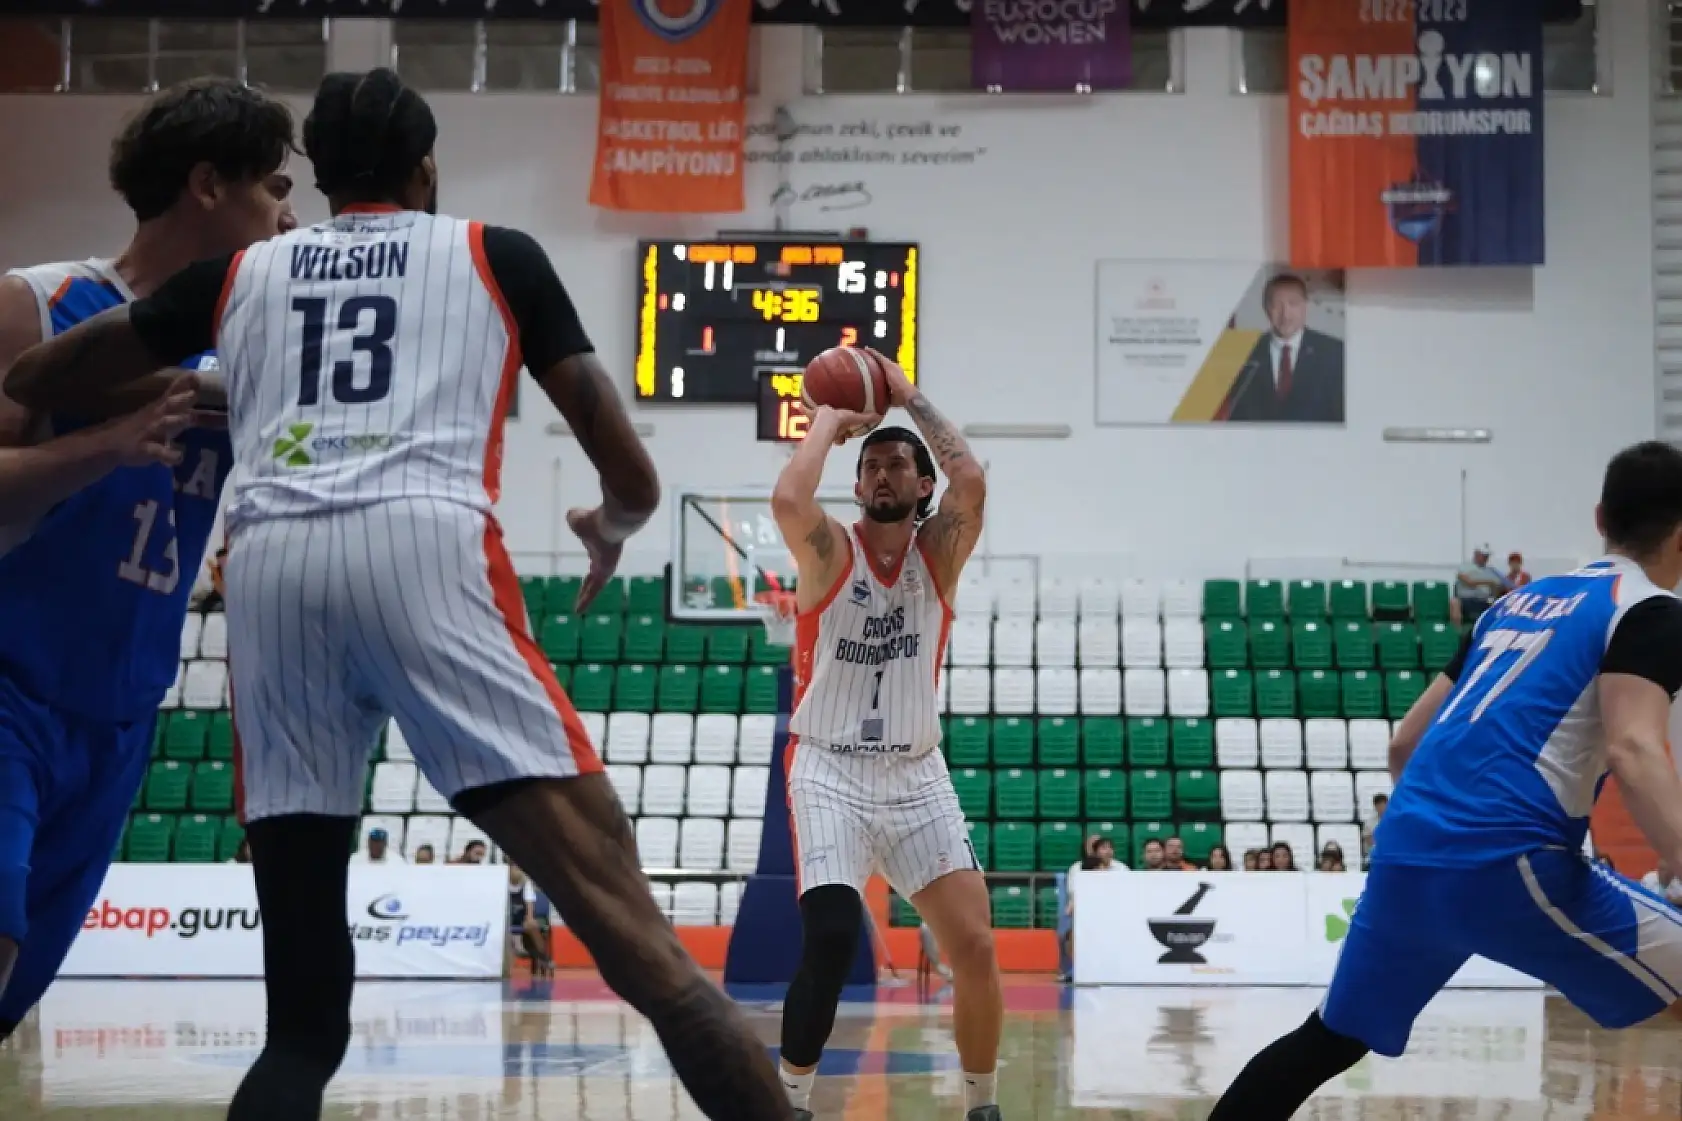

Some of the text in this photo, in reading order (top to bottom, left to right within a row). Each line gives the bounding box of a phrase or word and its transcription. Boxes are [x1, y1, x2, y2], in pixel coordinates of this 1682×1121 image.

[994, 20, 1106, 44] WOMEN
[939, 124, 961, 136] ve
[1388, 109, 1532, 135] BODRUMSPOR
[291, 242, 409, 280] WILSON
[704, 259, 733, 291] 11
[838, 261, 866, 293] 15
[753, 288, 819, 322] 4:36
[292, 294, 397, 407] 13
[872, 671, 884, 710] 1
[1436, 628, 1555, 725] 77
[82, 899, 261, 939] ebap.guru
[397, 920, 491, 947] peyzaj
